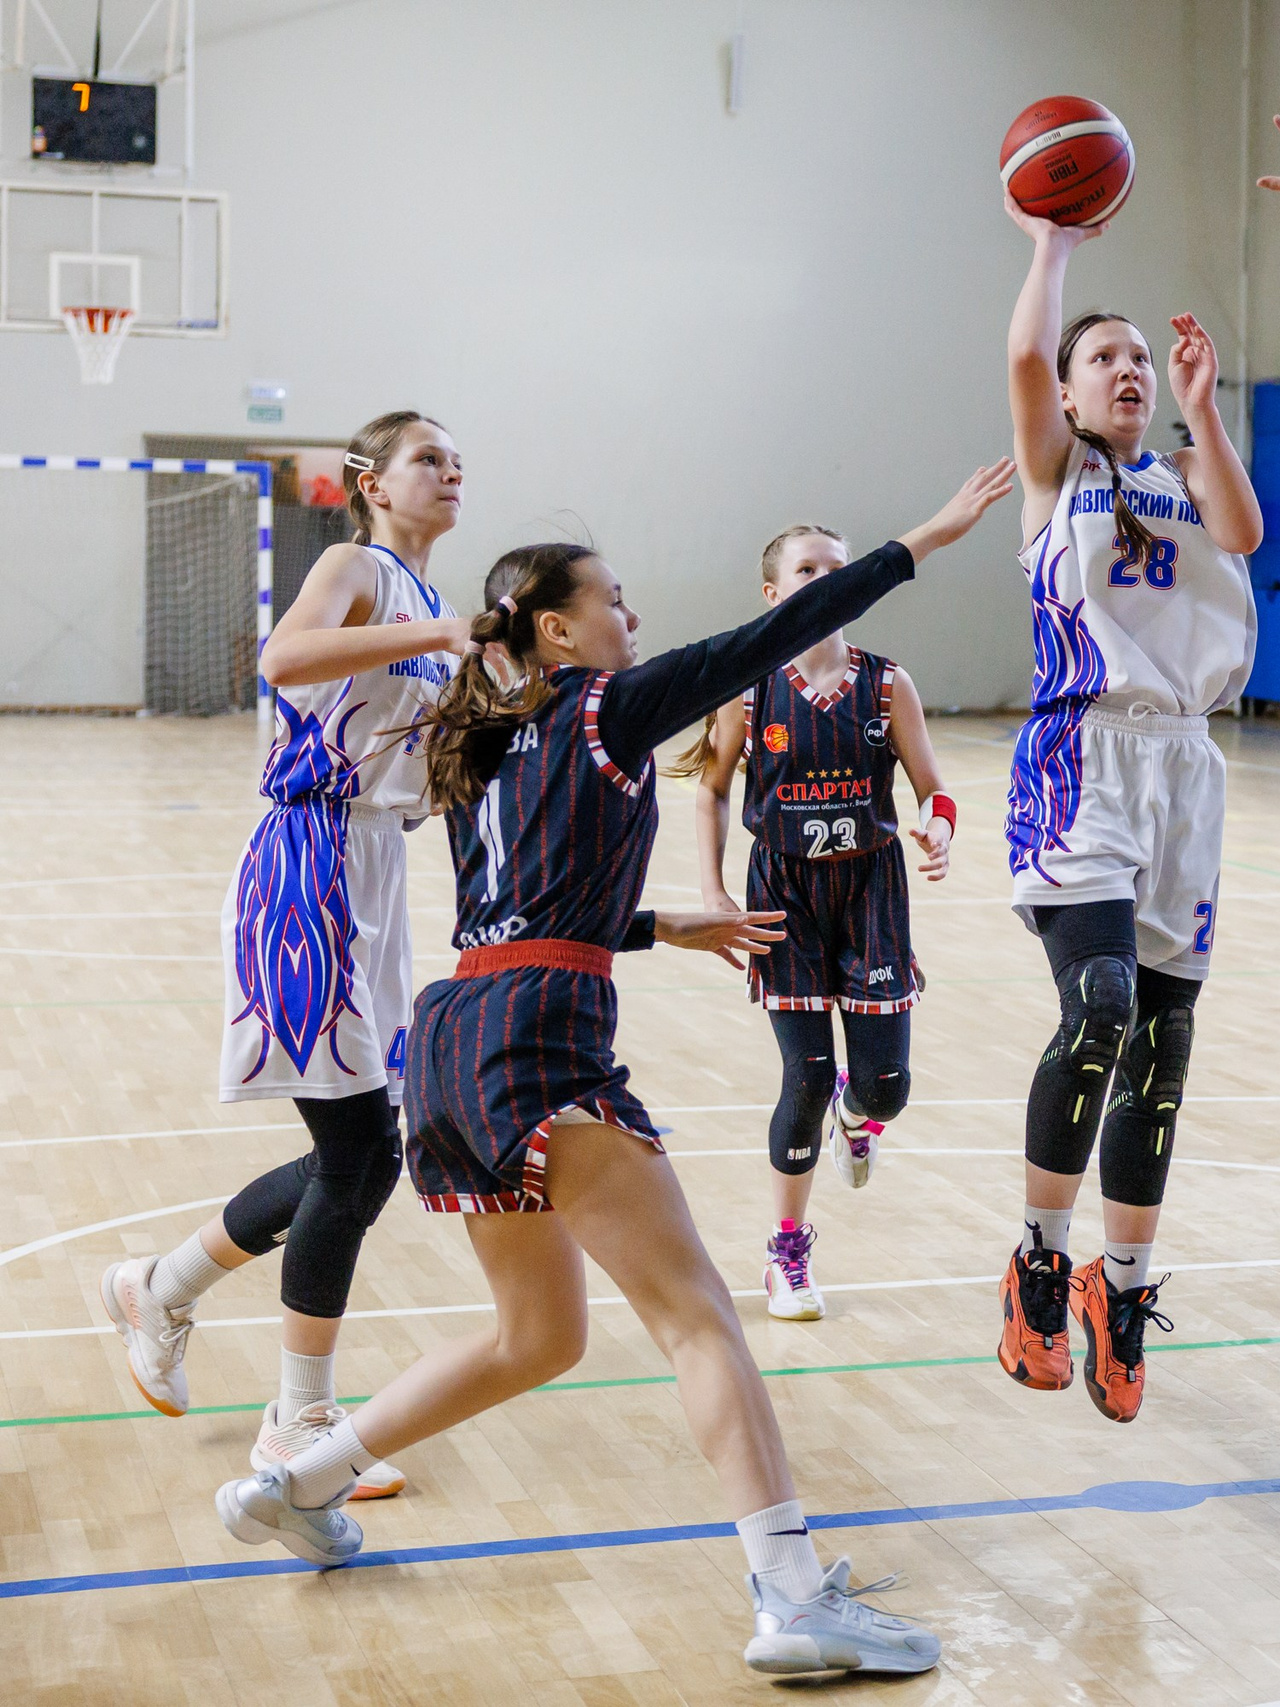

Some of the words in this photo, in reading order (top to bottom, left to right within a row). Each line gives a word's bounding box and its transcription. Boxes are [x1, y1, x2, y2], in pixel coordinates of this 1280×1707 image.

[71, 82, 91, 112] 7
[1048, 159, 1080, 184] FIBA
[1177, 499, 1206, 529] ПО
[1107, 531, 1179, 591] 28
[780, 803, 820, 811] Московская
[821, 802, 848, 810] область
[803, 816, 857, 859] 23
[868, 965, 895, 986] ШФК
